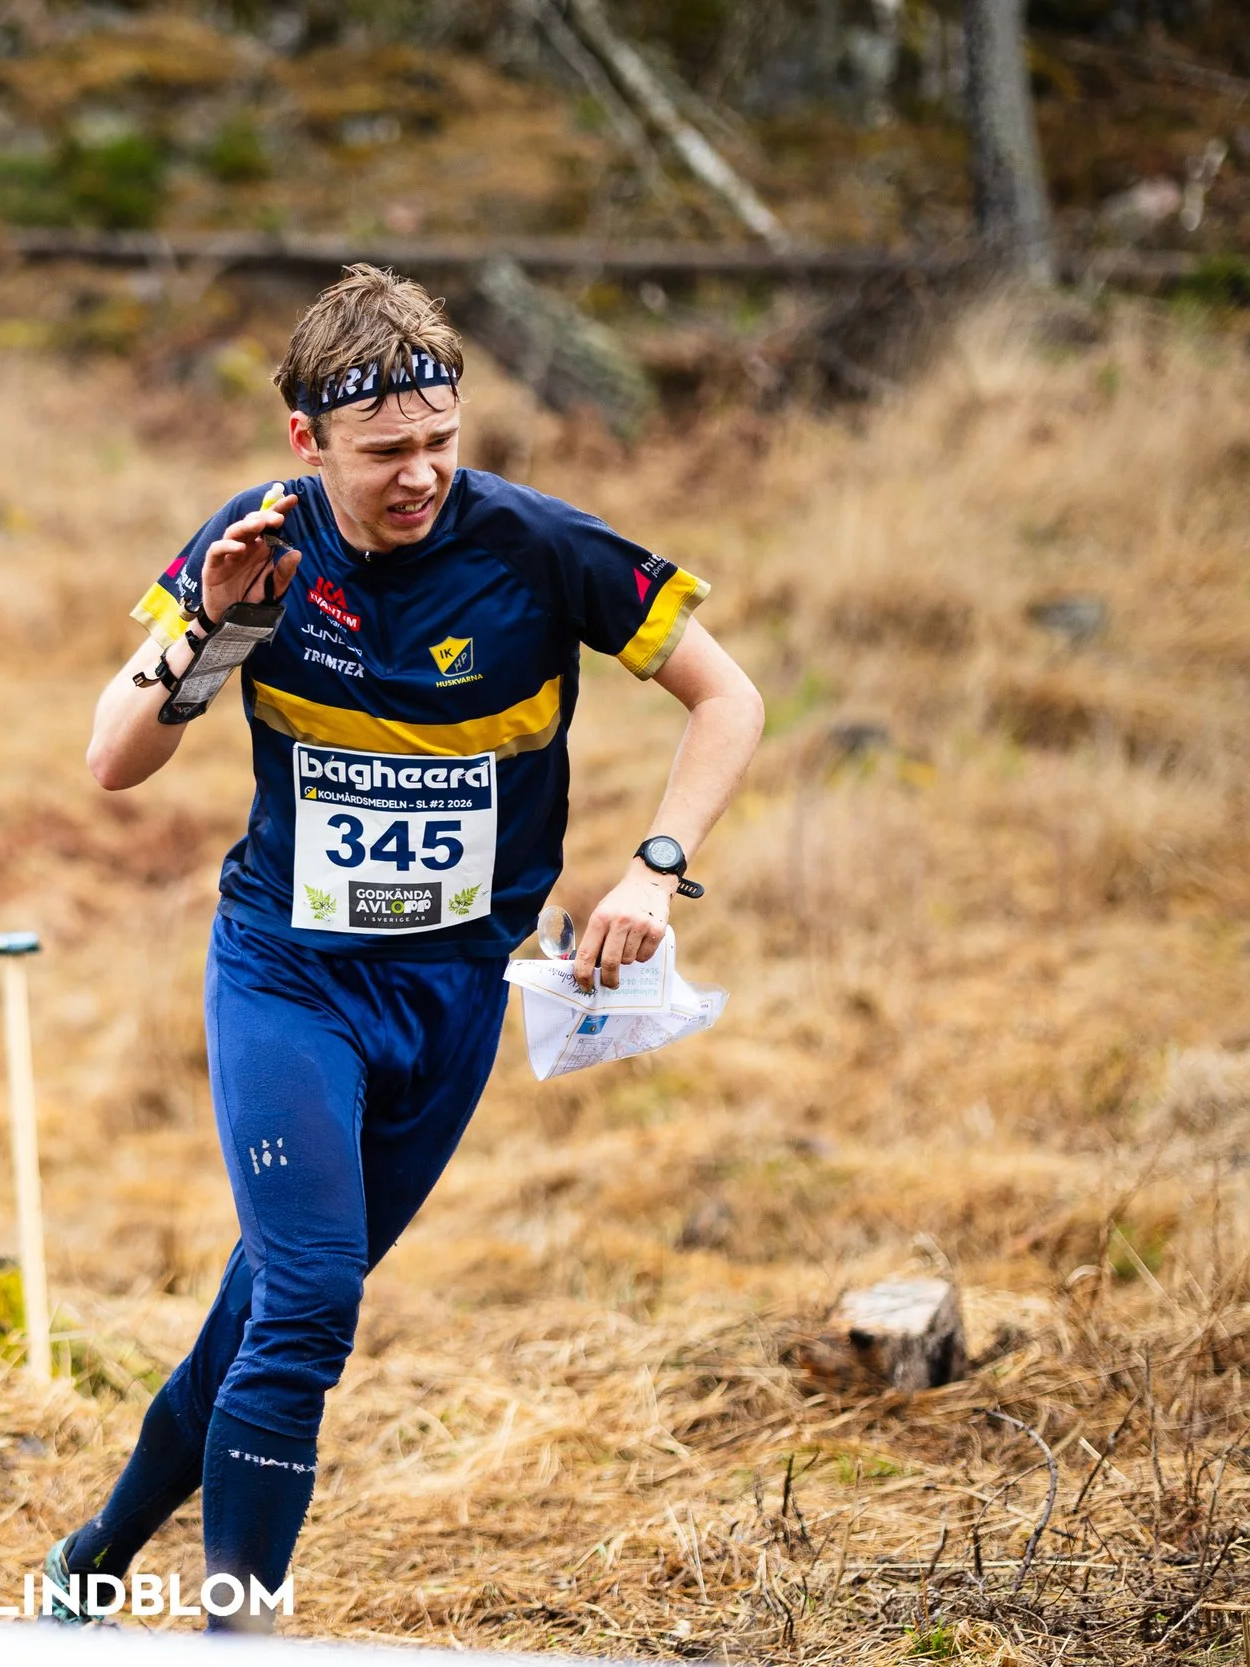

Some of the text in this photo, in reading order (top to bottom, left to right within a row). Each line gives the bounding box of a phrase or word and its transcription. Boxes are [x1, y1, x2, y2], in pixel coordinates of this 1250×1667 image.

[315, 576, 348, 610] ICA
[303, 647, 365, 678] TRIMTEX
[440, 648, 453, 660] IK
[454, 652, 468, 672] HP
[436, 673, 483, 688] HUSKVARNA
[318, 791, 407, 809] KOLMÅRDSMEDELN
[416, 800, 428, 809] SL
[429, 800, 444, 808] #2
[447, 799, 473, 808] 2026
[325, 813, 465, 871] 345
[356, 888, 433, 900] GODKÄNDA
